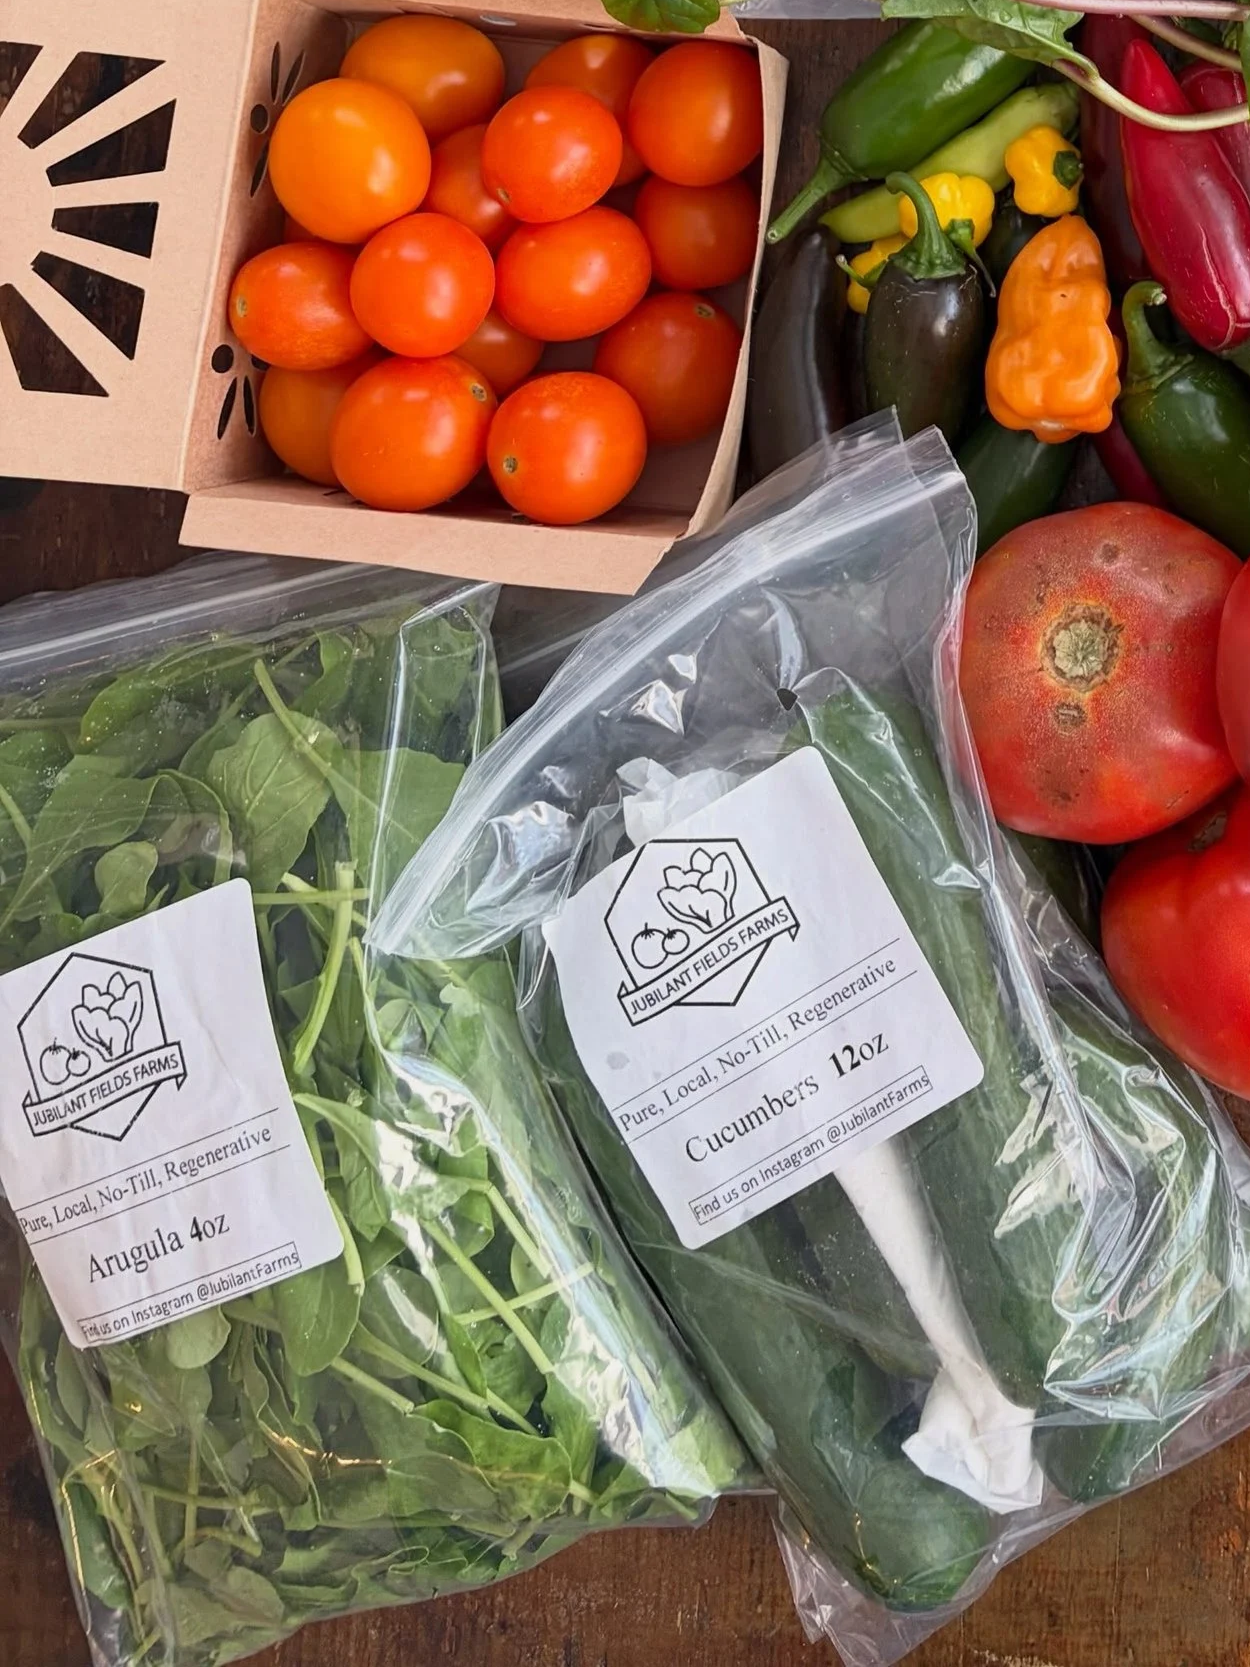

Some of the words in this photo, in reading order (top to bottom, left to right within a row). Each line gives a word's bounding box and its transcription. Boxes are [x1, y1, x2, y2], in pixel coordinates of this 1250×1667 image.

[631, 968, 692, 1015] JUBILANT
[693, 937, 738, 976] FIELDS
[738, 909, 788, 944] FARMS
[33, 1092, 86, 1126] JUBILANT
[89, 1070, 131, 1103] FIELDS
[133, 1053, 178, 1081] FARMS
[619, 1104, 664, 1131] Pure,
[662, 1066, 718, 1106] Local,
[716, 1024, 788, 1074] No-Till,
[787, 960, 895, 1030] Regenerative
[686, 1076, 818, 1162] Cucumbers
[829, 1033, 888, 1077] 12oz
[18, 1216, 53, 1236] Pure,
[52, 1194, 97, 1223] Local,
[97, 1168, 162, 1207] No-Till,
[164, 1128, 271, 1181] Regenerative
[691, 1196, 721, 1220] Find
[722, 1188, 739, 1203] us
[741, 1177, 759, 1193] on
[759, 1139, 824, 1182] Instagram
[827, 1075, 931, 1143] @JubilantFarms
[90, 1228, 184, 1283] Arugula
[190, 1214, 229, 1242] 4oz
[100, 1323, 111, 1335] us
[113, 1317, 129, 1330] on
[131, 1292, 194, 1324] Instagram
[197, 1252, 299, 1301] @JubilantFarms
